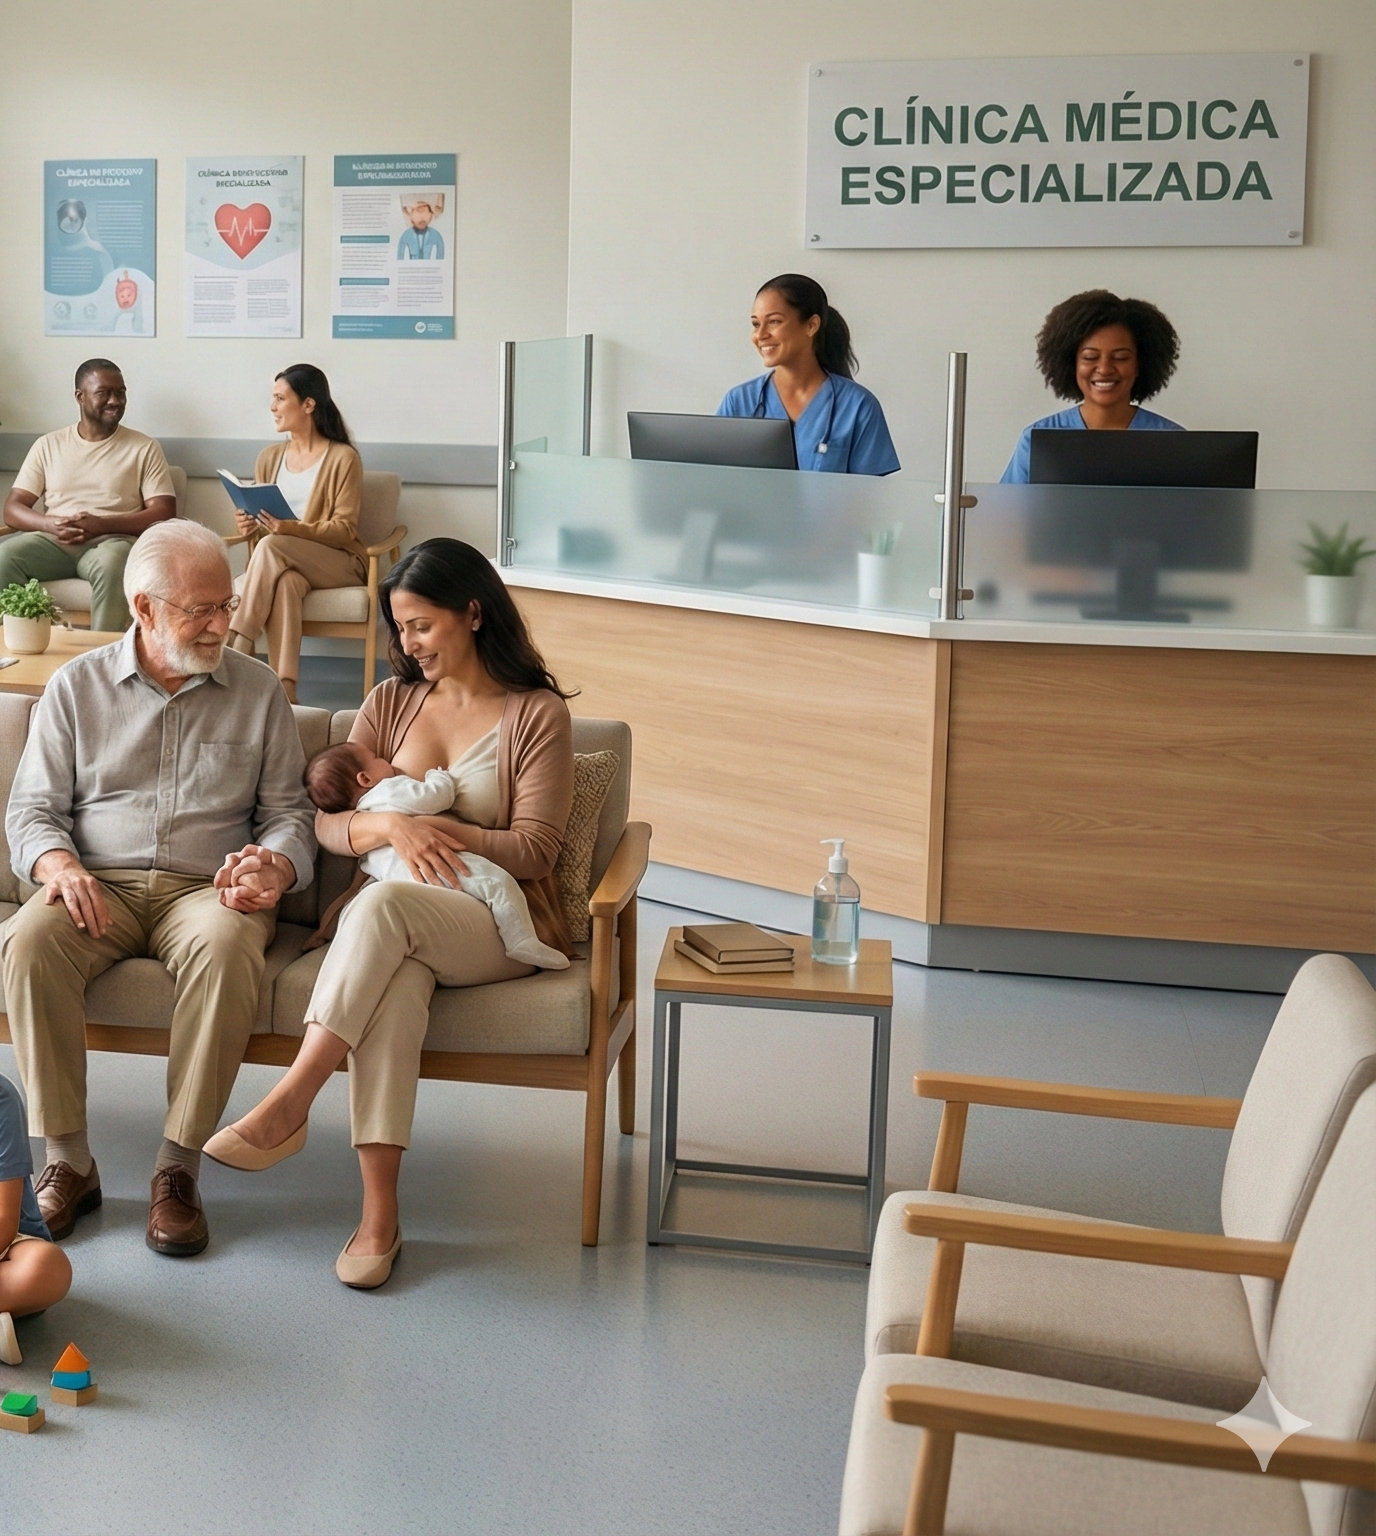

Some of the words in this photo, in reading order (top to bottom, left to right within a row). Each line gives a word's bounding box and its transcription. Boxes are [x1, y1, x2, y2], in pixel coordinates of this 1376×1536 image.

[834, 95, 1050, 147] CLÍNICA
[1065, 90, 1280, 143] MÉDICA
[840, 160, 1274, 206] ESPECIALIZADA
